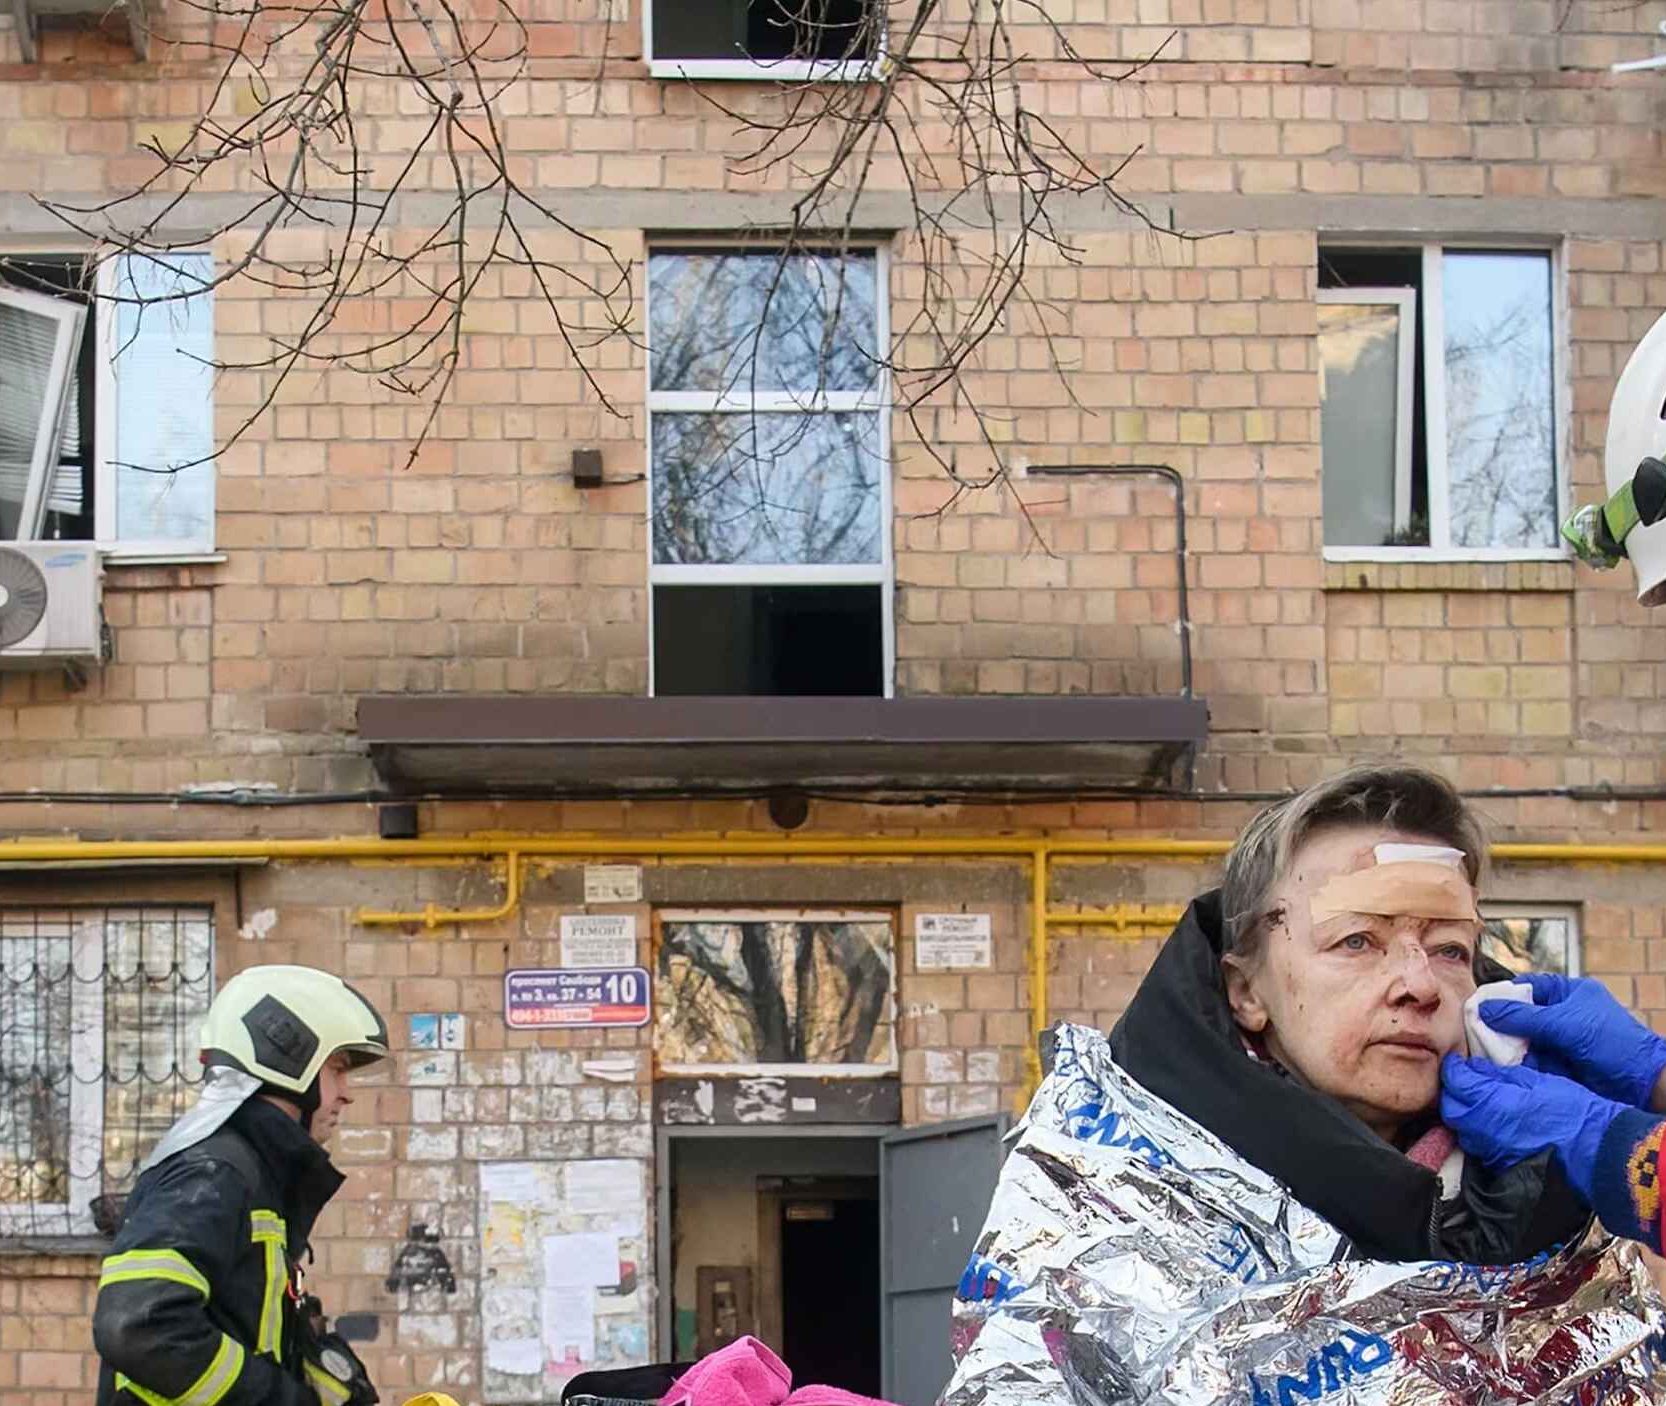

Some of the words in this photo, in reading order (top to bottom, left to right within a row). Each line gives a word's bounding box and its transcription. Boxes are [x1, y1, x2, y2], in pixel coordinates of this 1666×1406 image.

[572, 927, 624, 937] РЕМОНТ
[561, 988, 576, 1000] 37
[605, 974, 637, 1003] 10
